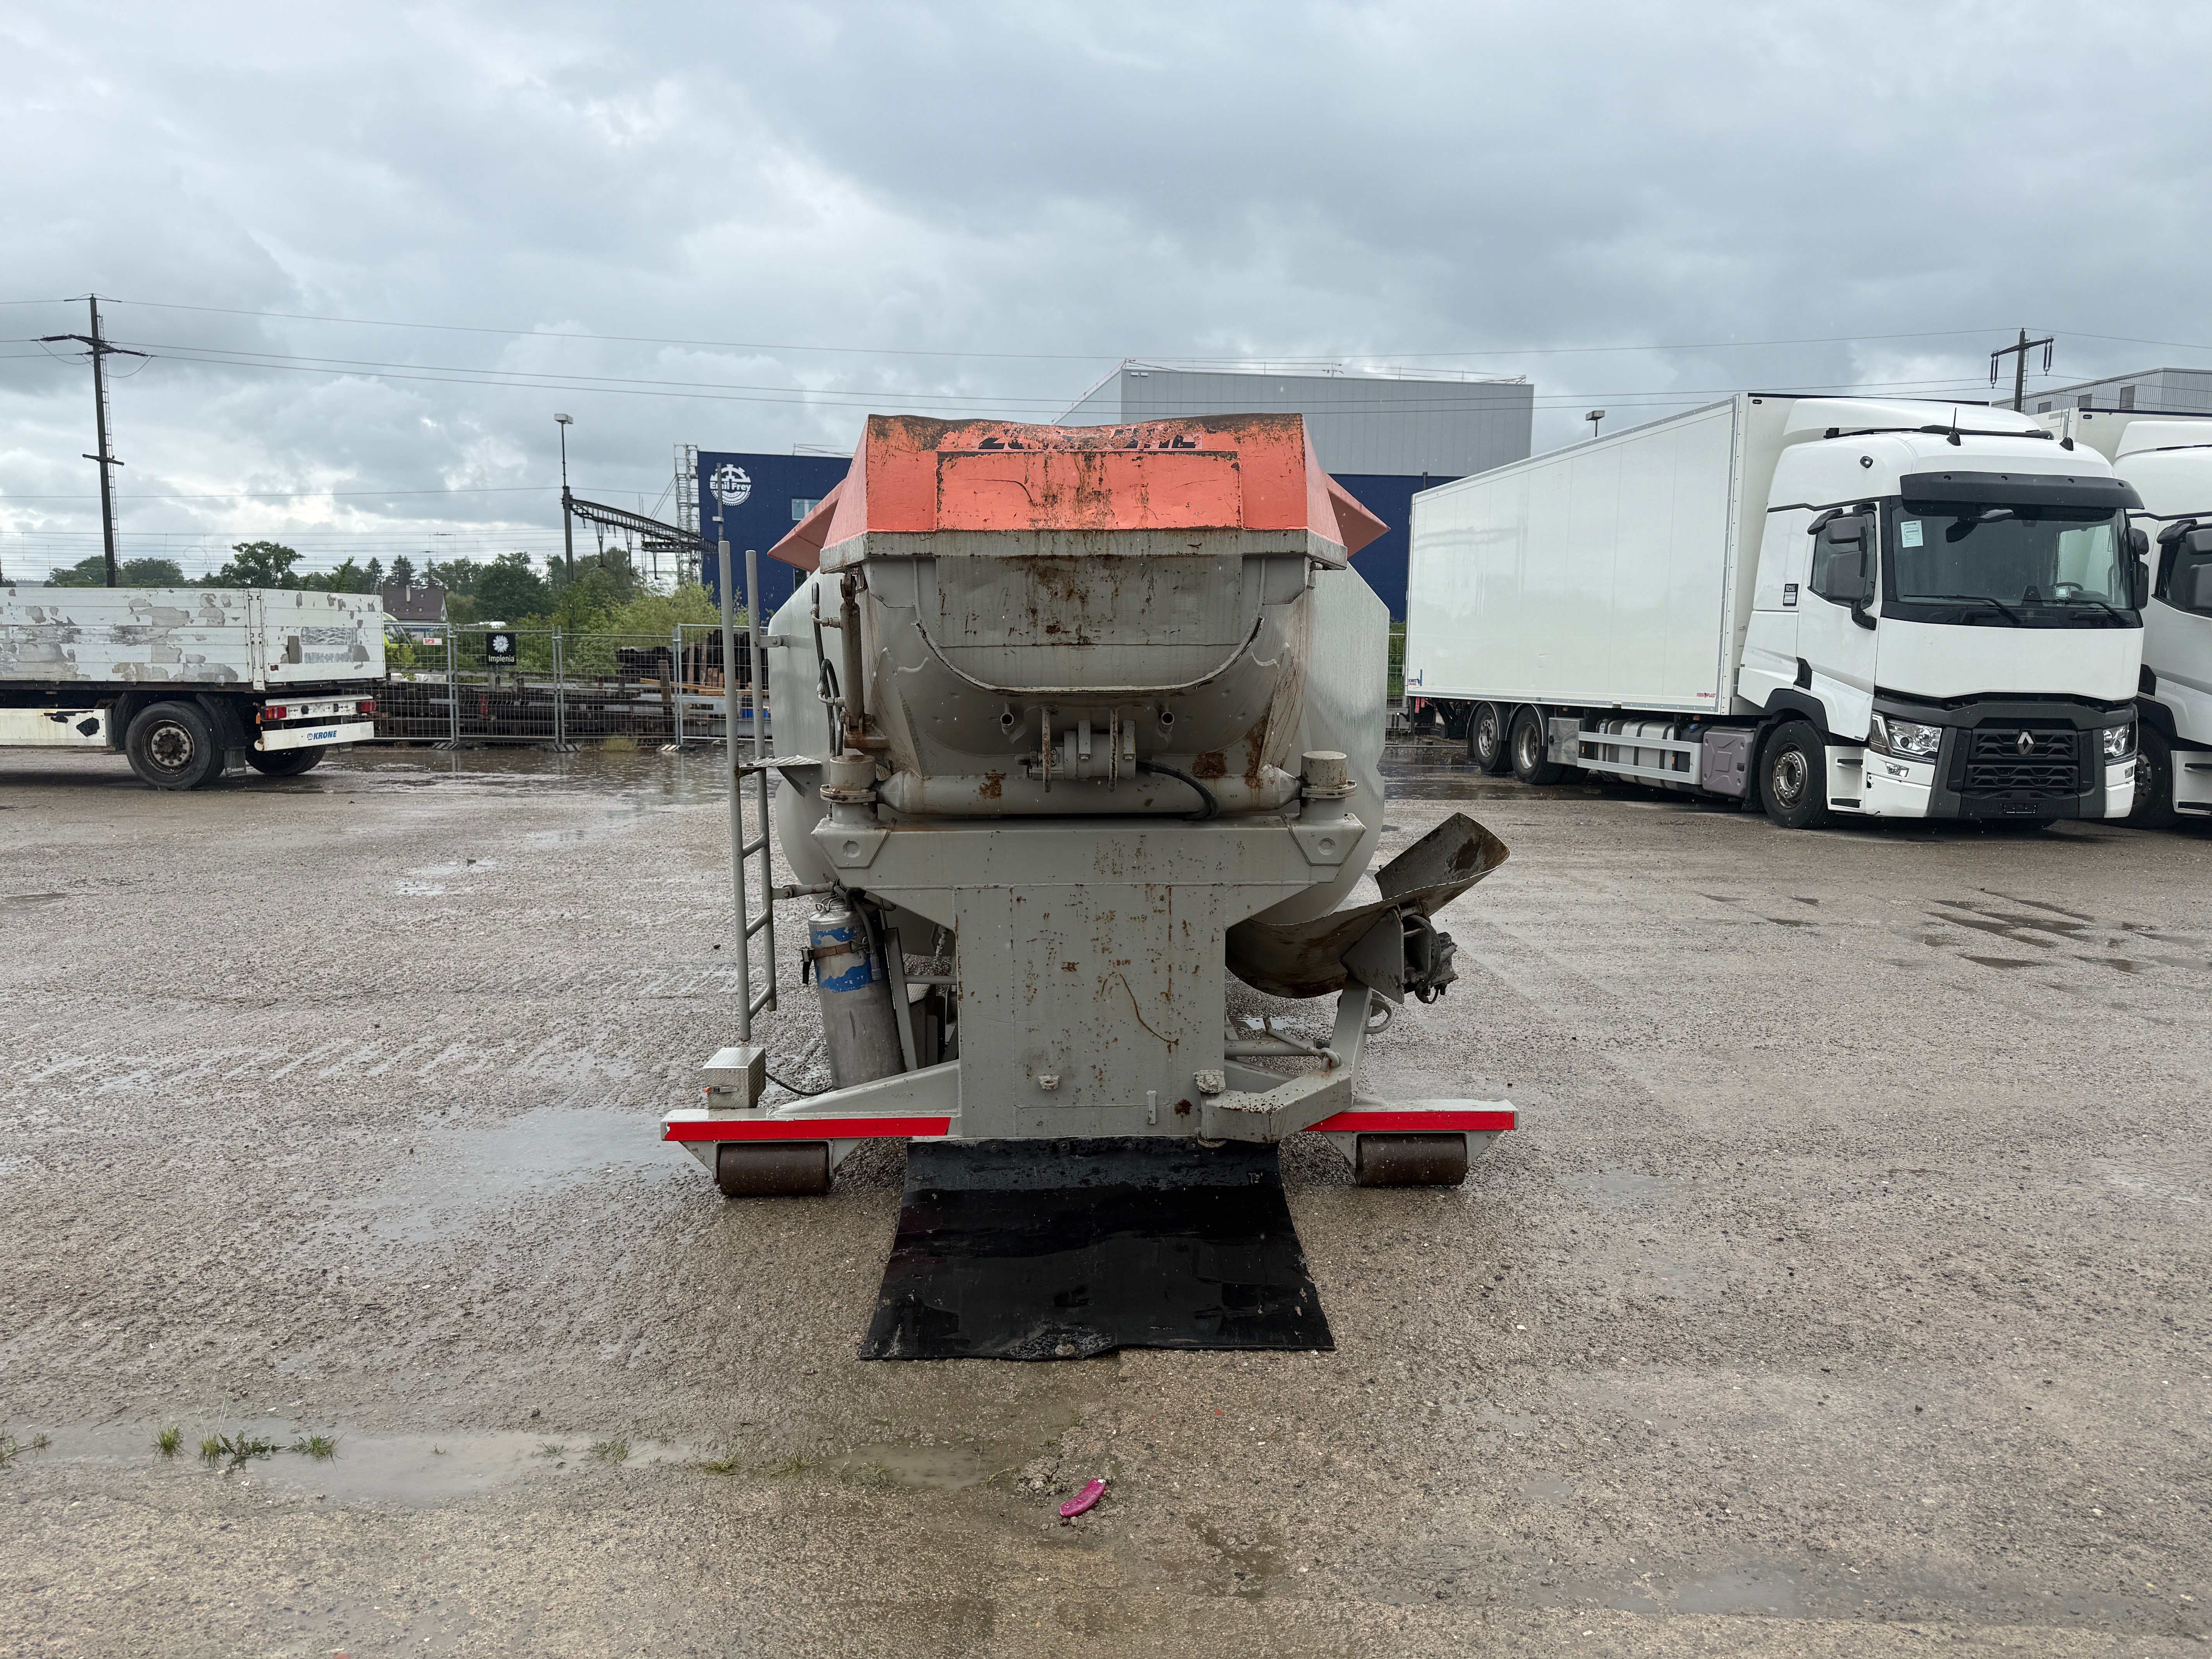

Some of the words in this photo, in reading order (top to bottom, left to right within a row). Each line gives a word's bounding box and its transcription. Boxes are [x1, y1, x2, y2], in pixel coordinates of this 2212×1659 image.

[710, 481, 730, 489] Emil
[732, 483, 751, 493] Frey
[489, 654, 515, 664] Implenia
[313, 730, 337, 740] KRONE
